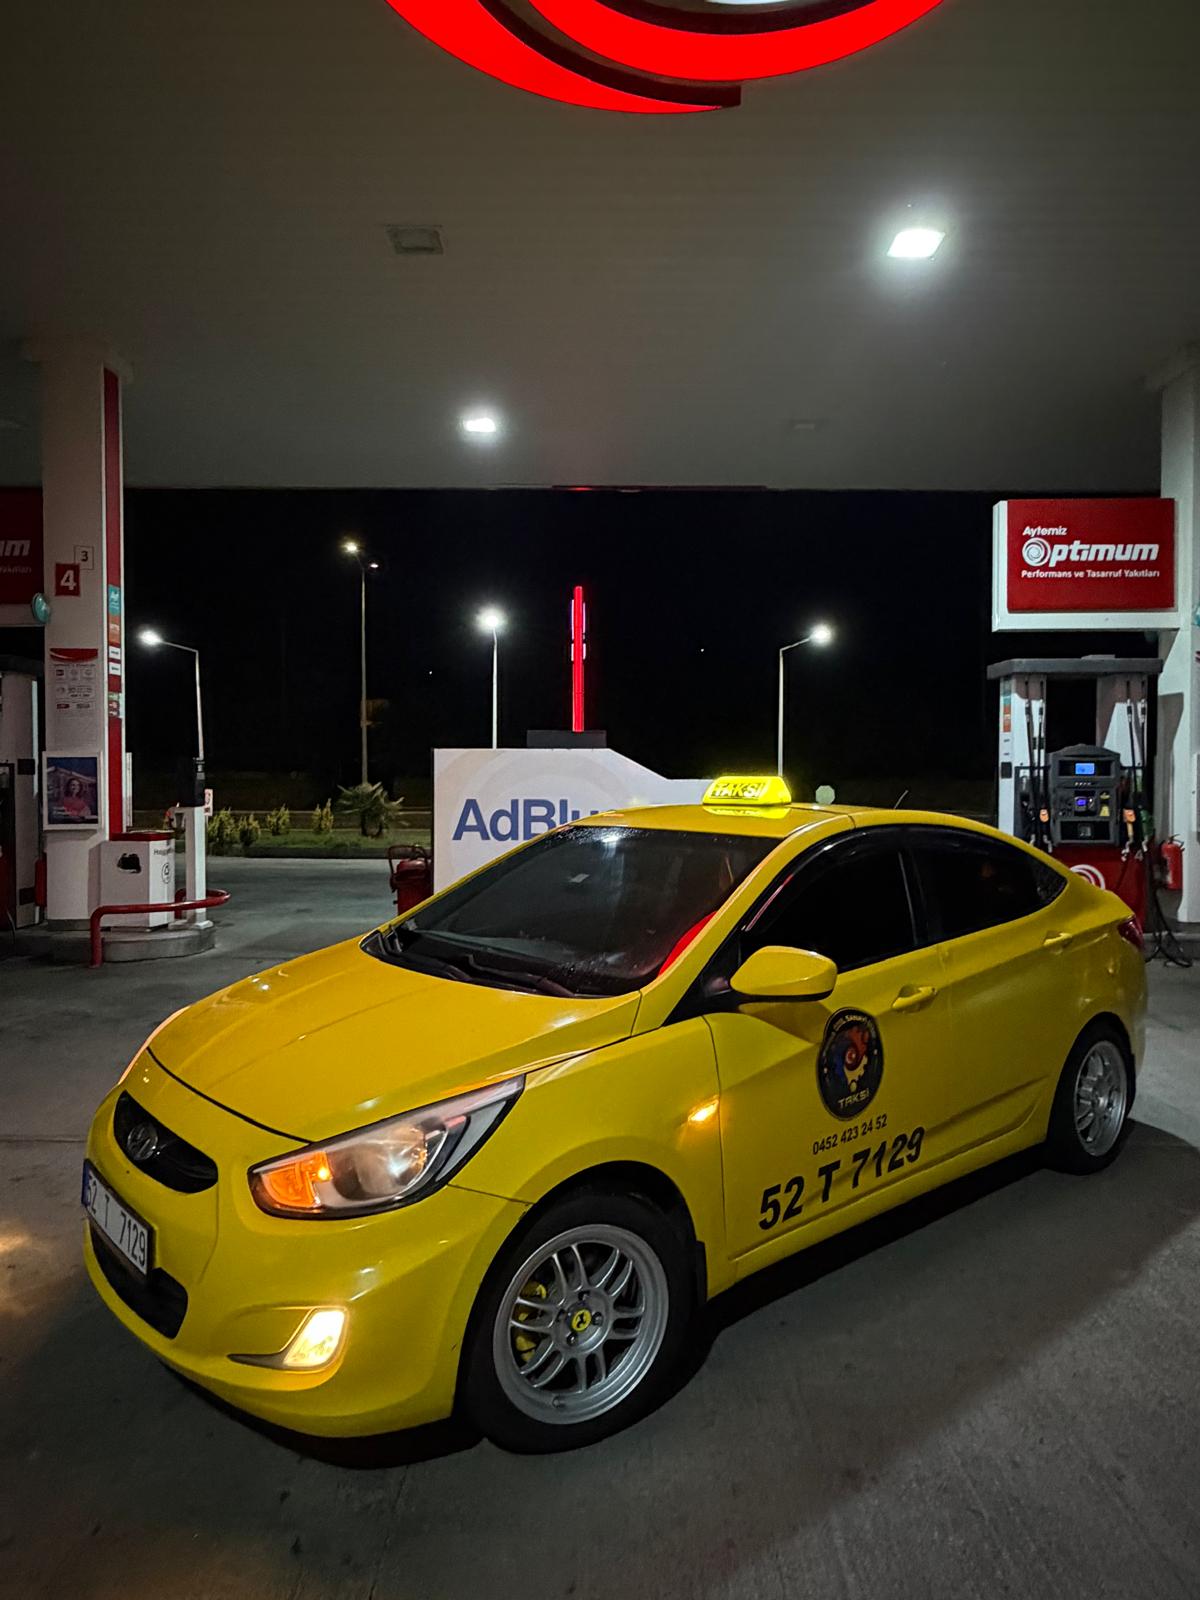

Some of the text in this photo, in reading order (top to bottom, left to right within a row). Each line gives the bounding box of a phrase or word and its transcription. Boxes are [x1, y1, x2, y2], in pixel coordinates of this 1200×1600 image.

[81, 550, 89, 562] 3
[60, 570, 77, 591] 4
[1021, 569, 1072, 578] Performans
[1086, 569, 1122, 578] Tasarruf
[812, 1113, 888, 1156] 0452 423 24 52
[758, 1126, 926, 1231] 52 T 7129
[119, 1211, 146, 1267] 7129
